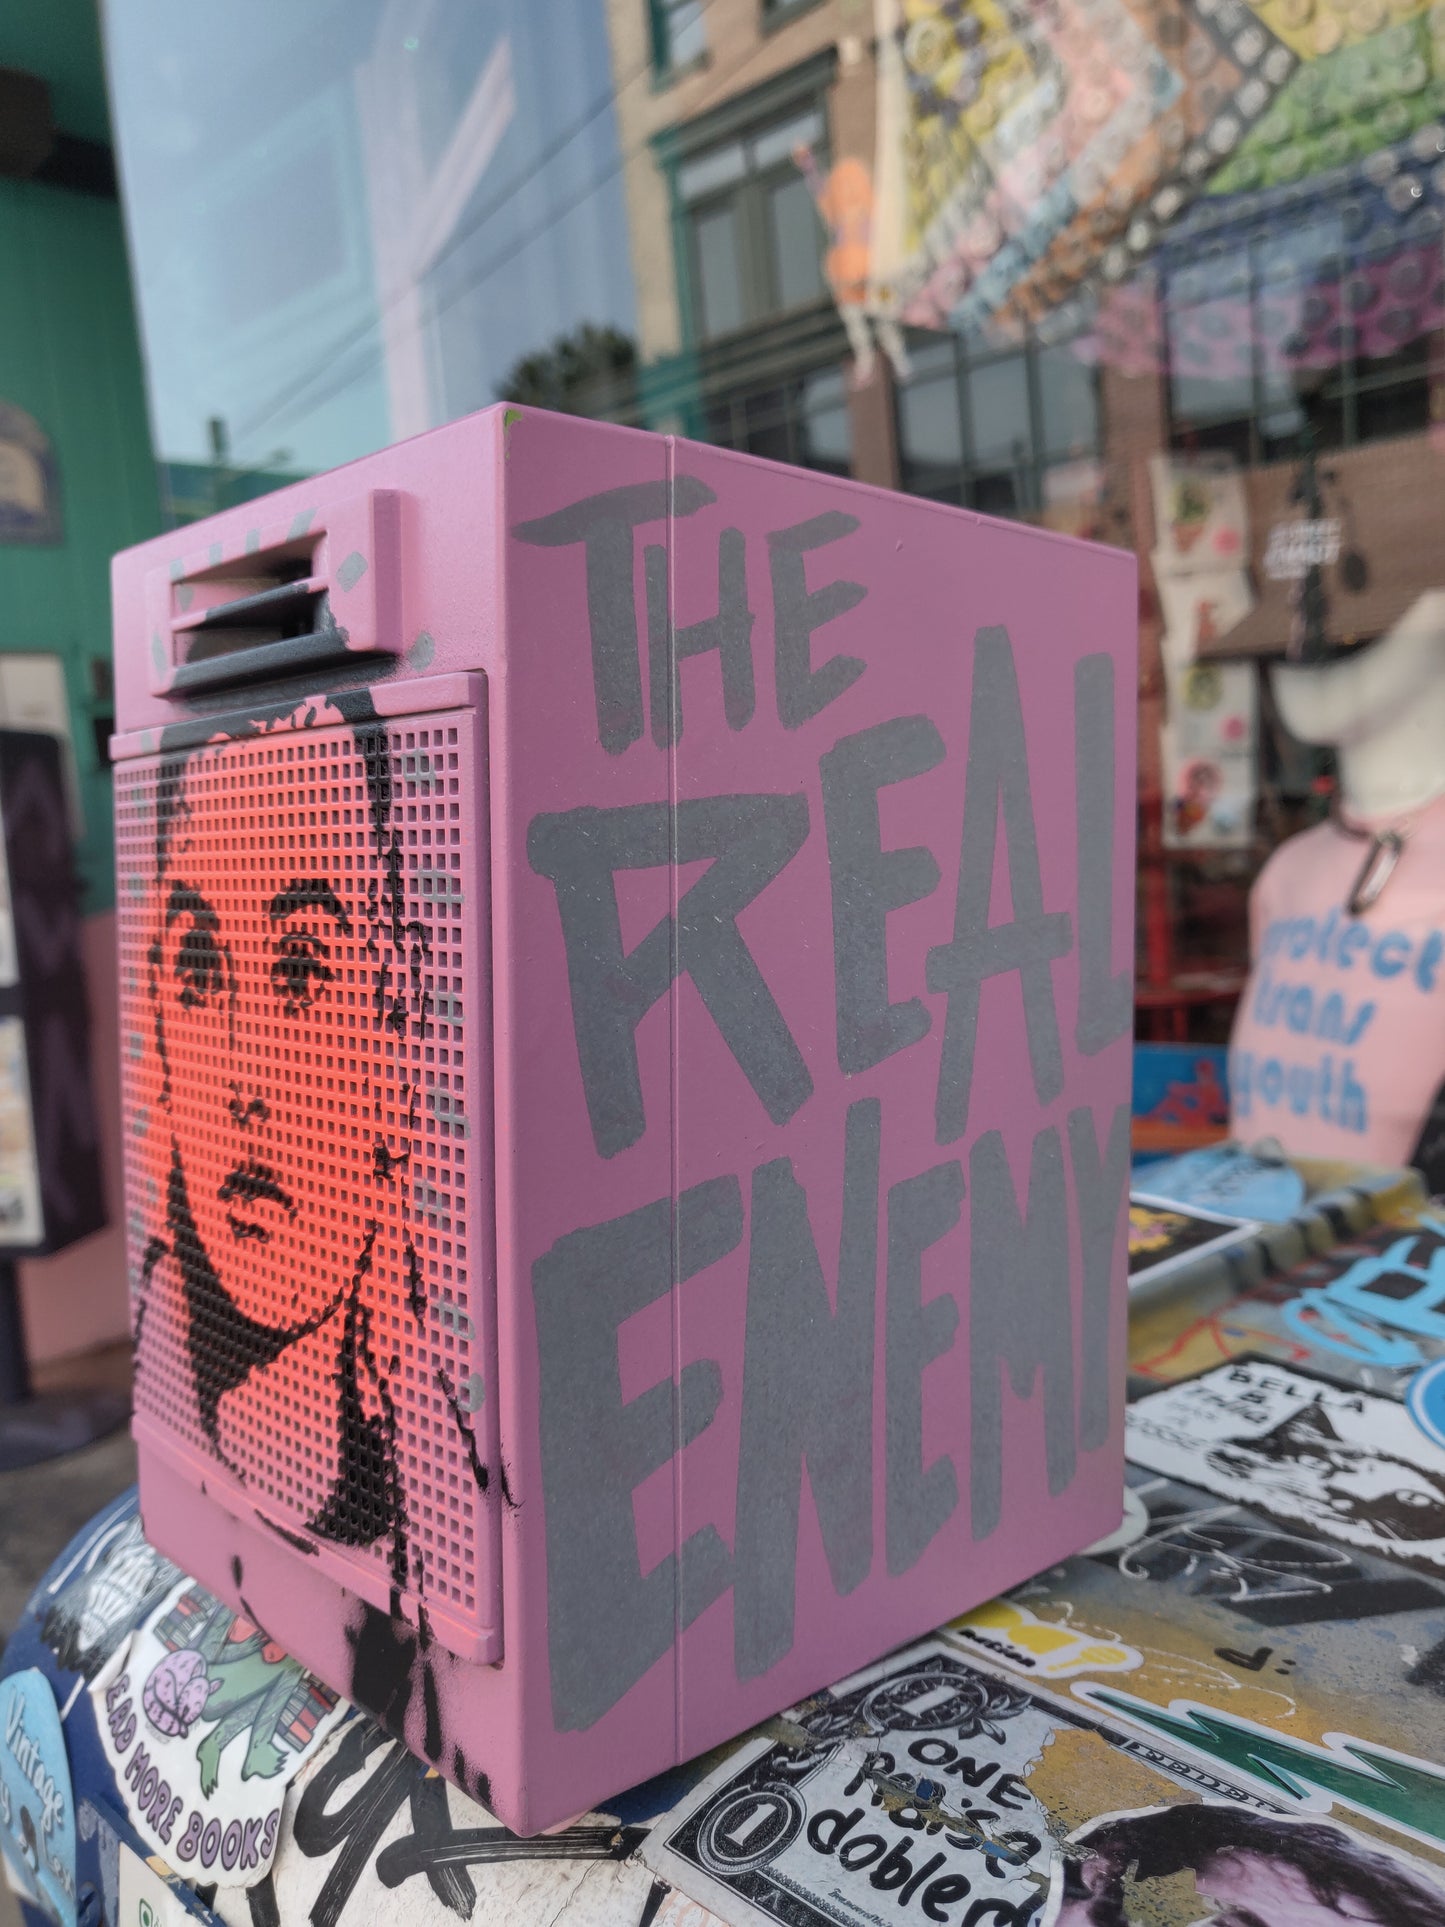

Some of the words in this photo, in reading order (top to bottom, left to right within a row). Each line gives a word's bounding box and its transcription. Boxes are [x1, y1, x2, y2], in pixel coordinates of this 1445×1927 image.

[512, 475, 868, 755] THE
[526, 624, 1133, 1159] REAL
[531, 1097, 1132, 1733] ENEMY
[6, 1684, 64, 1848] Vintage
[107, 1674, 137, 1754] EAD
[125, 1741, 184, 1846] MORE
[176, 1808, 280, 1871] BOOKS
[908, 1738, 1032, 1811] ONE
